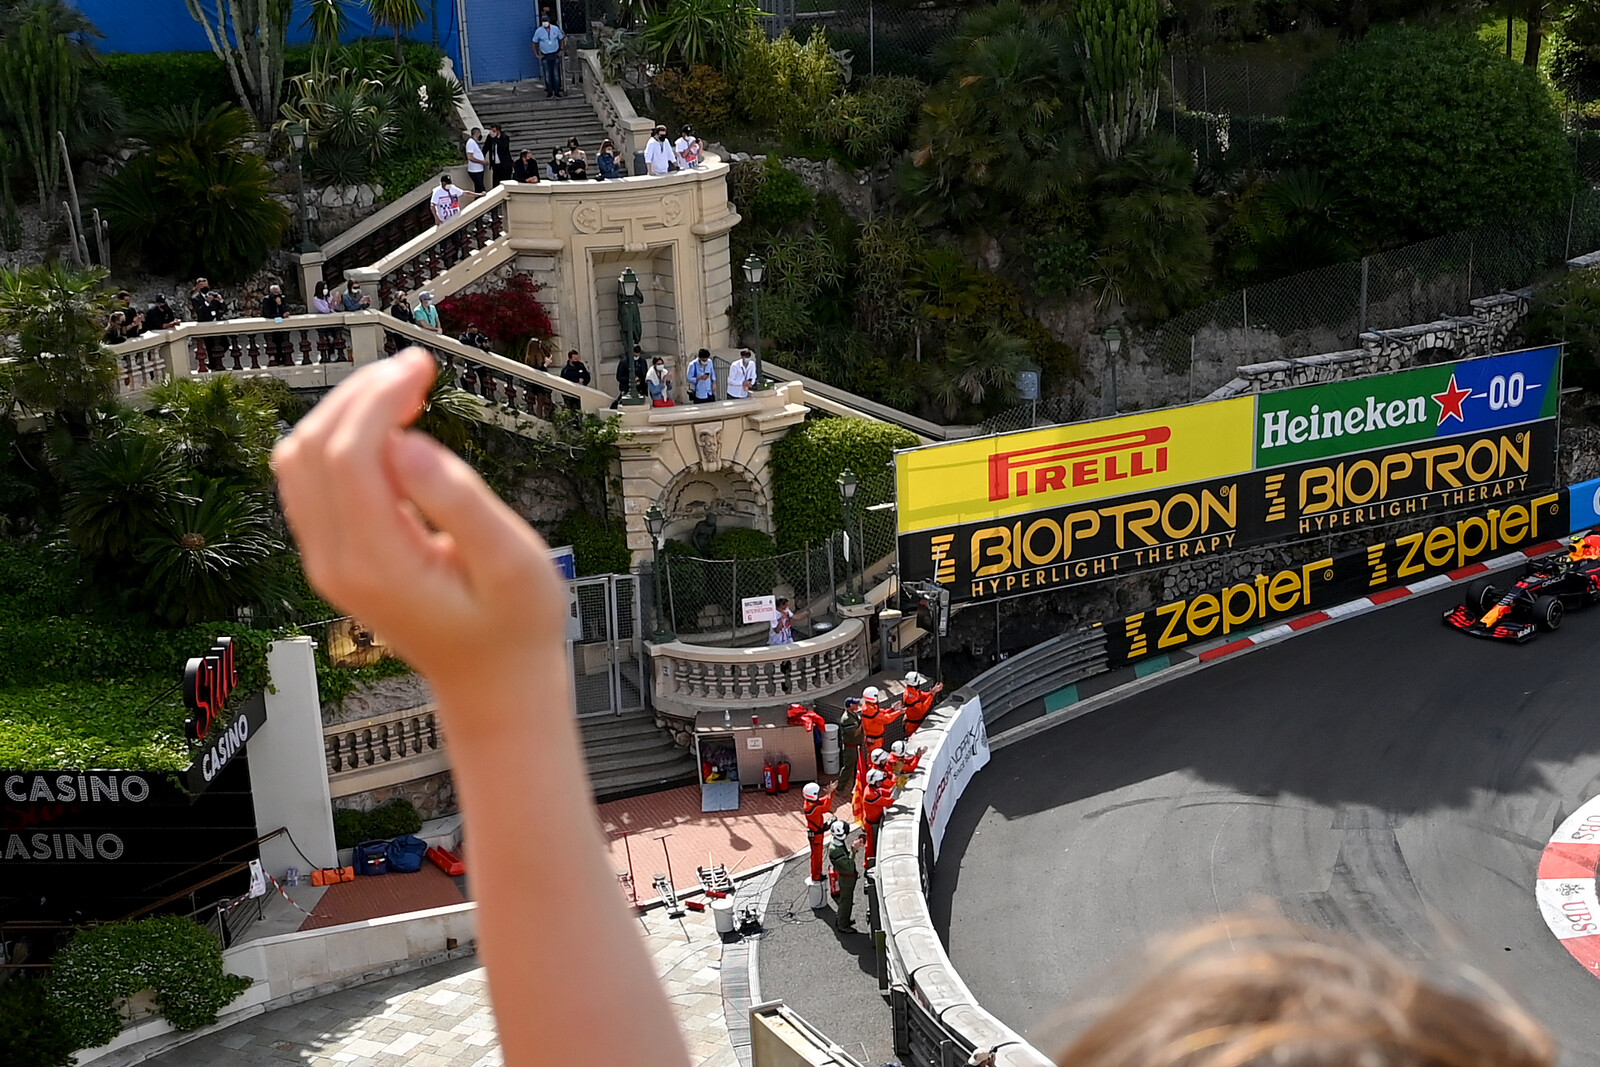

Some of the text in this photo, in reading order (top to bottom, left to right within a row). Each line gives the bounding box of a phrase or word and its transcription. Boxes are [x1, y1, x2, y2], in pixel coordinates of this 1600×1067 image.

[1261, 396, 1427, 449] Heineken
[989, 426, 1172, 502] PIRELLI
[1299, 430, 1531, 514] BIOPTRON
[971, 483, 1237, 577] BIOPTRON
[1299, 477, 1529, 534] HYPERLIGHT THERAPY
[1395, 493, 1559, 579] zepter
[971, 533, 1236, 598] HYPERLIGHT THERAPY
[1156, 558, 1333, 649] zepter
[202, 714, 249, 782] CASINO
[4, 775, 150, 802] CASINO
[0, 833, 124, 860] ASINO
[1562, 900, 1598, 934] UBS
